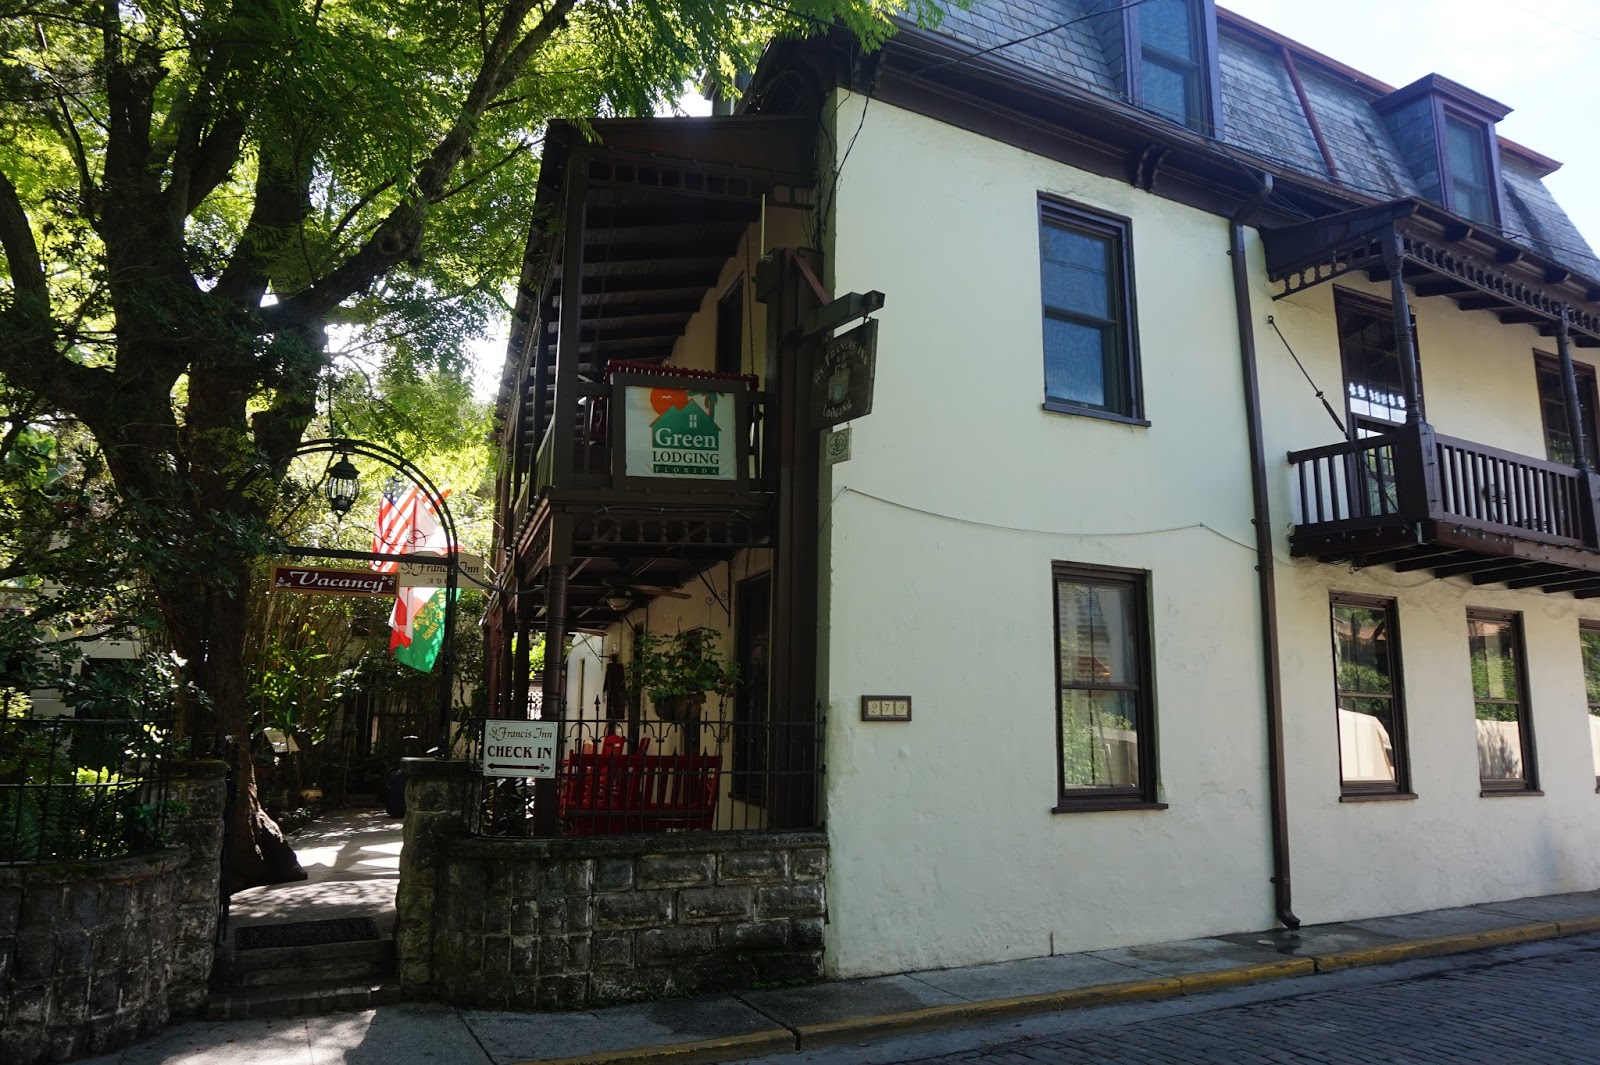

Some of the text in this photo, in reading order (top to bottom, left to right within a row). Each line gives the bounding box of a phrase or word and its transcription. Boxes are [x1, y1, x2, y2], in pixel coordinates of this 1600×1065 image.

[655, 427, 717, 449] Green
[652, 451, 719, 465] LODGING
[655, 467, 717, 475] FLORIDA
[412, 563, 447, 577] Franc
[457, 561, 479, 574] Inn
[290, 570, 384, 594] Vacancy
[872, 702, 904, 714] 279
[496, 726, 532, 741] Francis
[533, 727, 552, 739] Inn
[487, 745, 552, 759] CHECK IN
